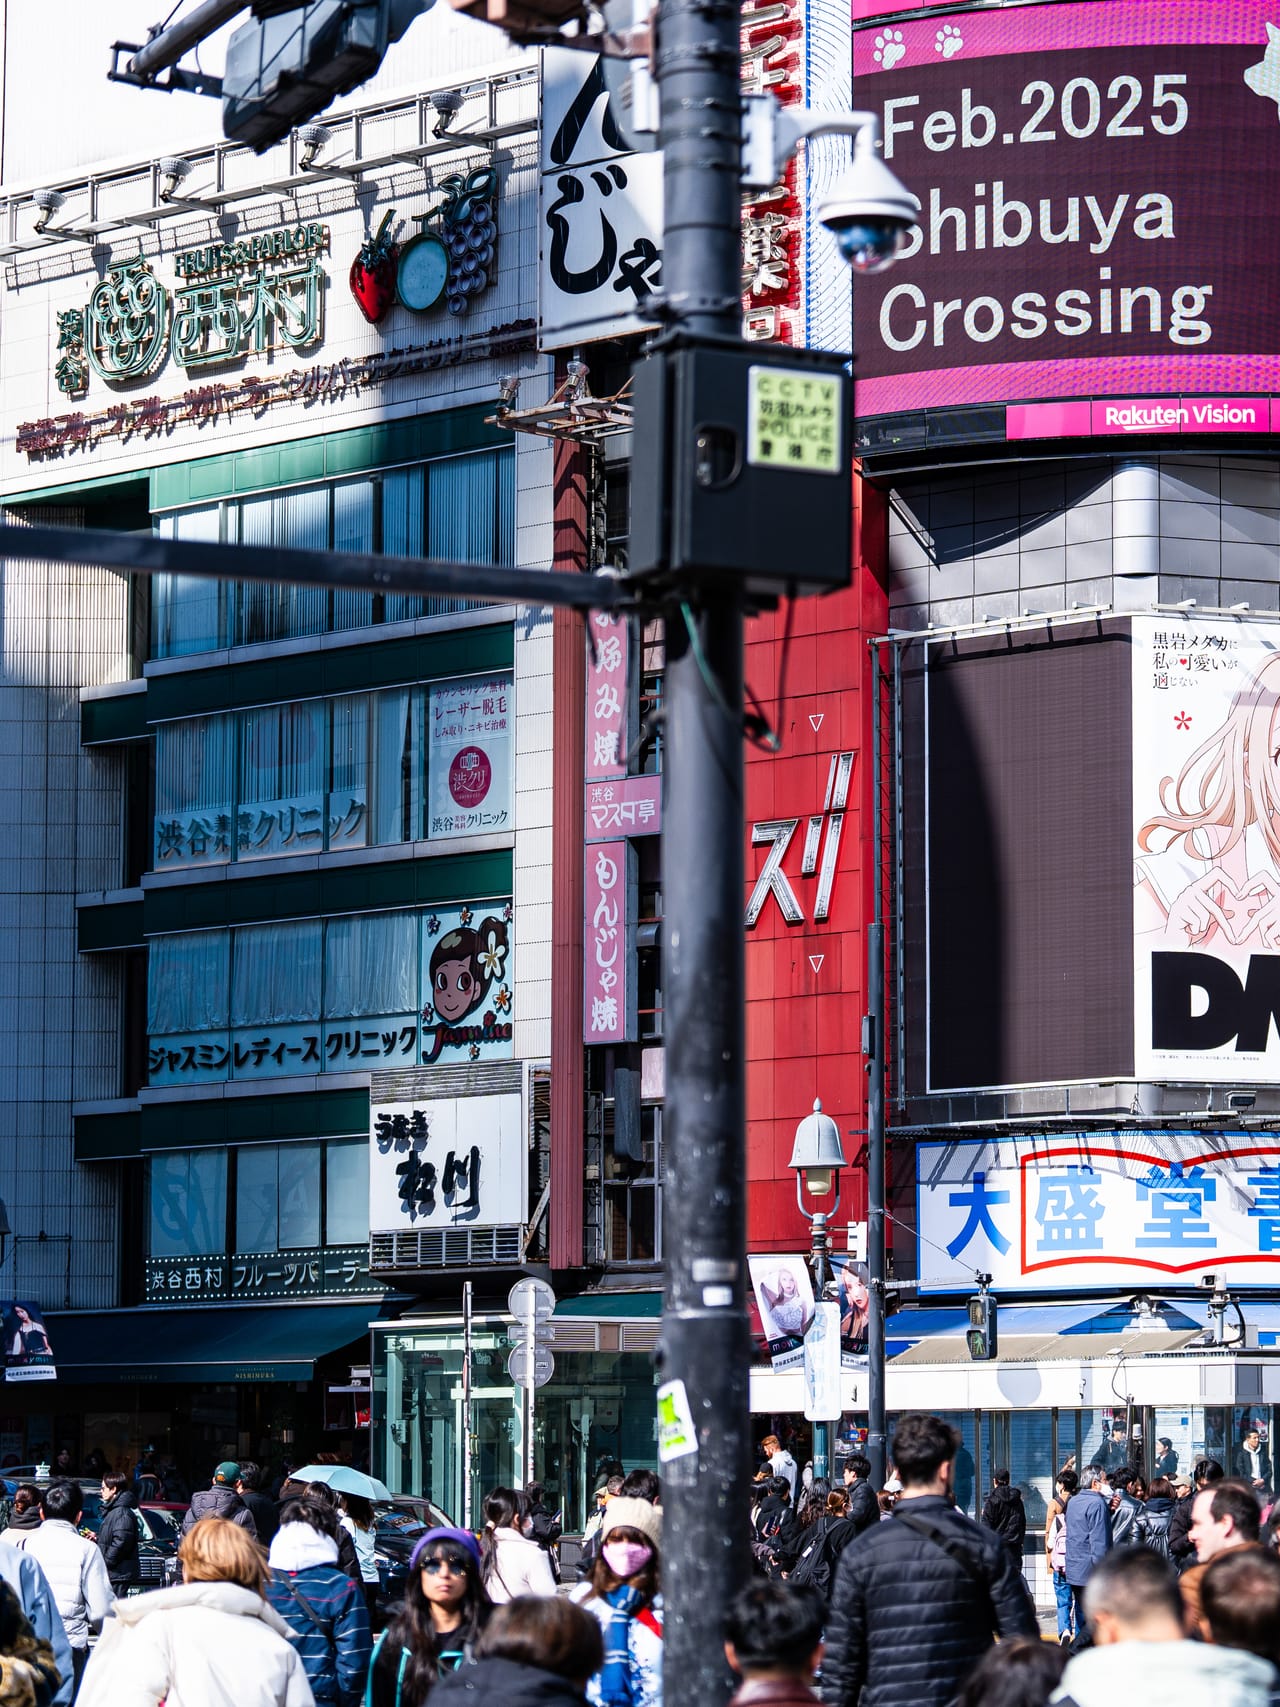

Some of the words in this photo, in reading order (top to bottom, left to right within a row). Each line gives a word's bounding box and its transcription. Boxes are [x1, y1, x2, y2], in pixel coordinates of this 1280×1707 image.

[883, 73, 1189, 159] Feb.2025
[172, 258, 318, 368] 西村
[879, 267, 1213, 352] Crossing
[757, 377, 835, 401] CCTV
[1106, 406, 1189, 431] Rakuten
[1193, 404, 1256, 426] Vision
[1152, 631, 1238, 651] 黒岩メダカに
[435, 679, 507, 700] カウンセリング無料
[434, 695, 508, 721] レーザー脱毛
[453, 769, 487, 792] 渋クリ
[591, 786, 615, 802] 渋谷
[157, 817, 213, 860] 渋谷
[254, 799, 367, 849] クリニック
[432, 816, 454, 833] 渋谷
[466, 809, 508, 830] クリニック
[591, 851, 619, 1033] もんじゃ焼
[151, 1266, 223, 1291] 渋谷西村
